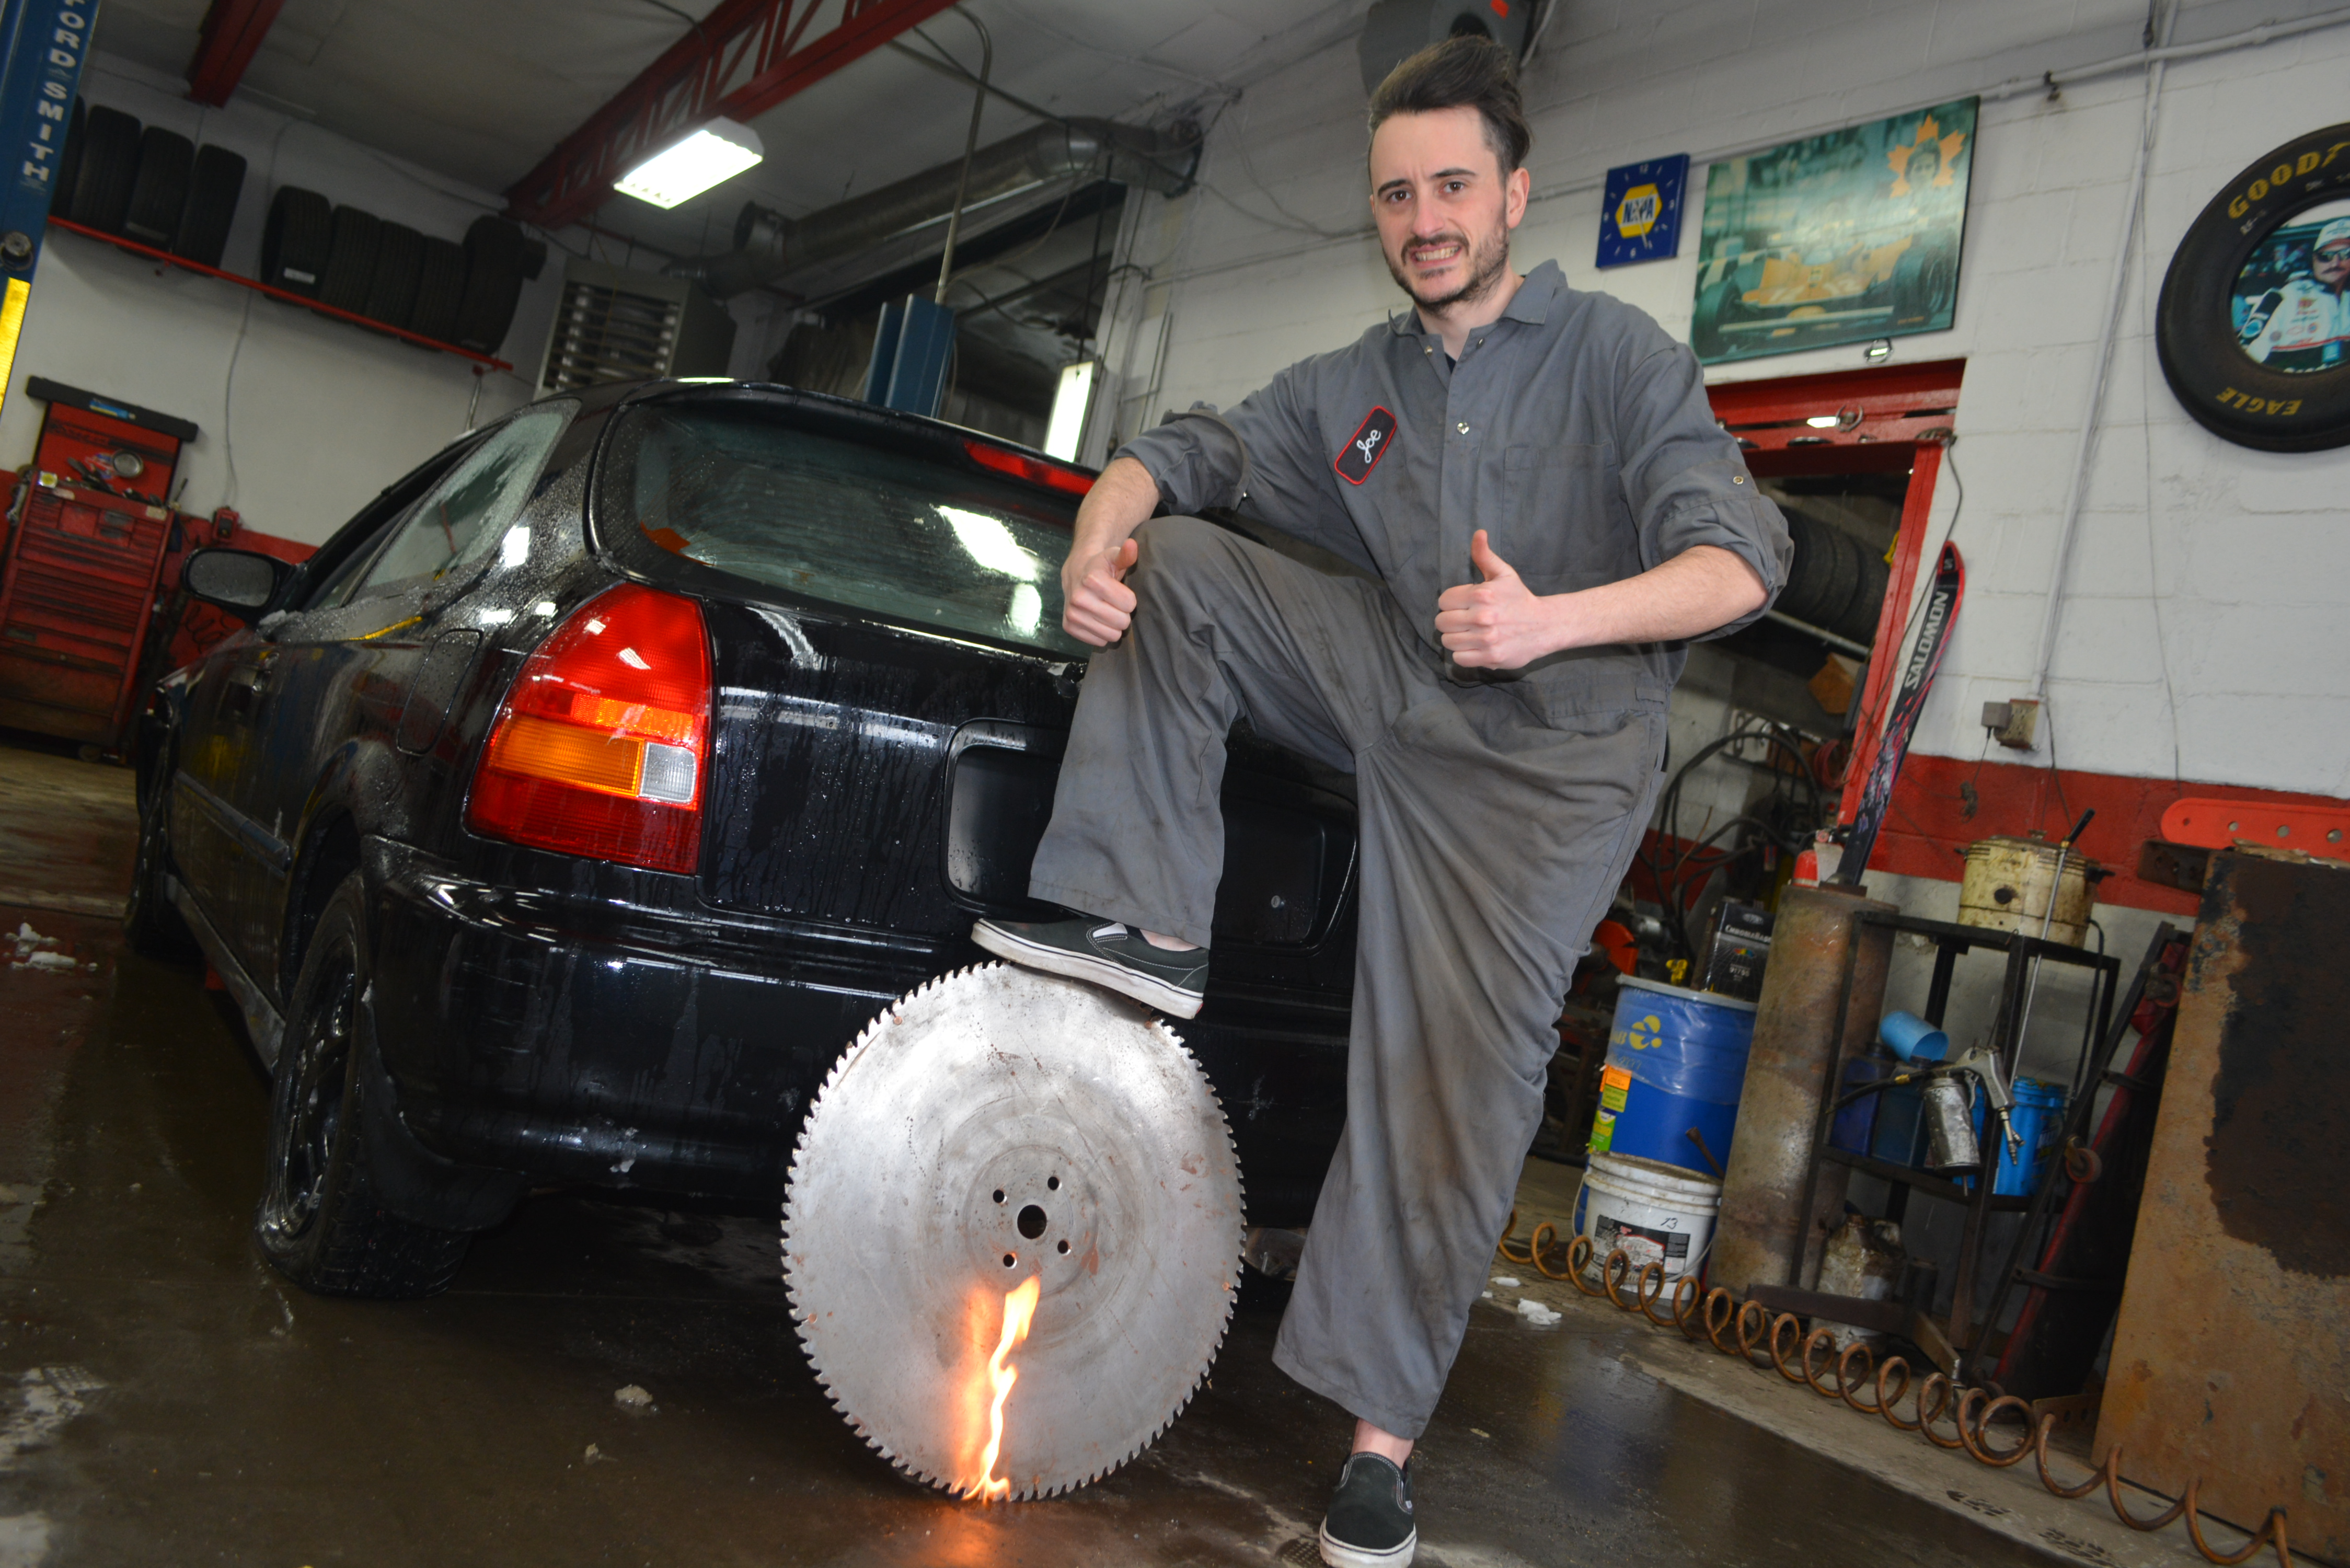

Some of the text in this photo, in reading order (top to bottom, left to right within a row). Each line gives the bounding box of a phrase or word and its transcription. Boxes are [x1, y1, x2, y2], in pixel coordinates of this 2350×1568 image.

[22, 81, 68, 182] SMITH
[1639, 164, 1649, 174] 12
[2216, 387, 2303, 416] EAGLE
[1904, 591, 1949, 690] SALOMON
[1661, 1217, 1678, 1229] 13
